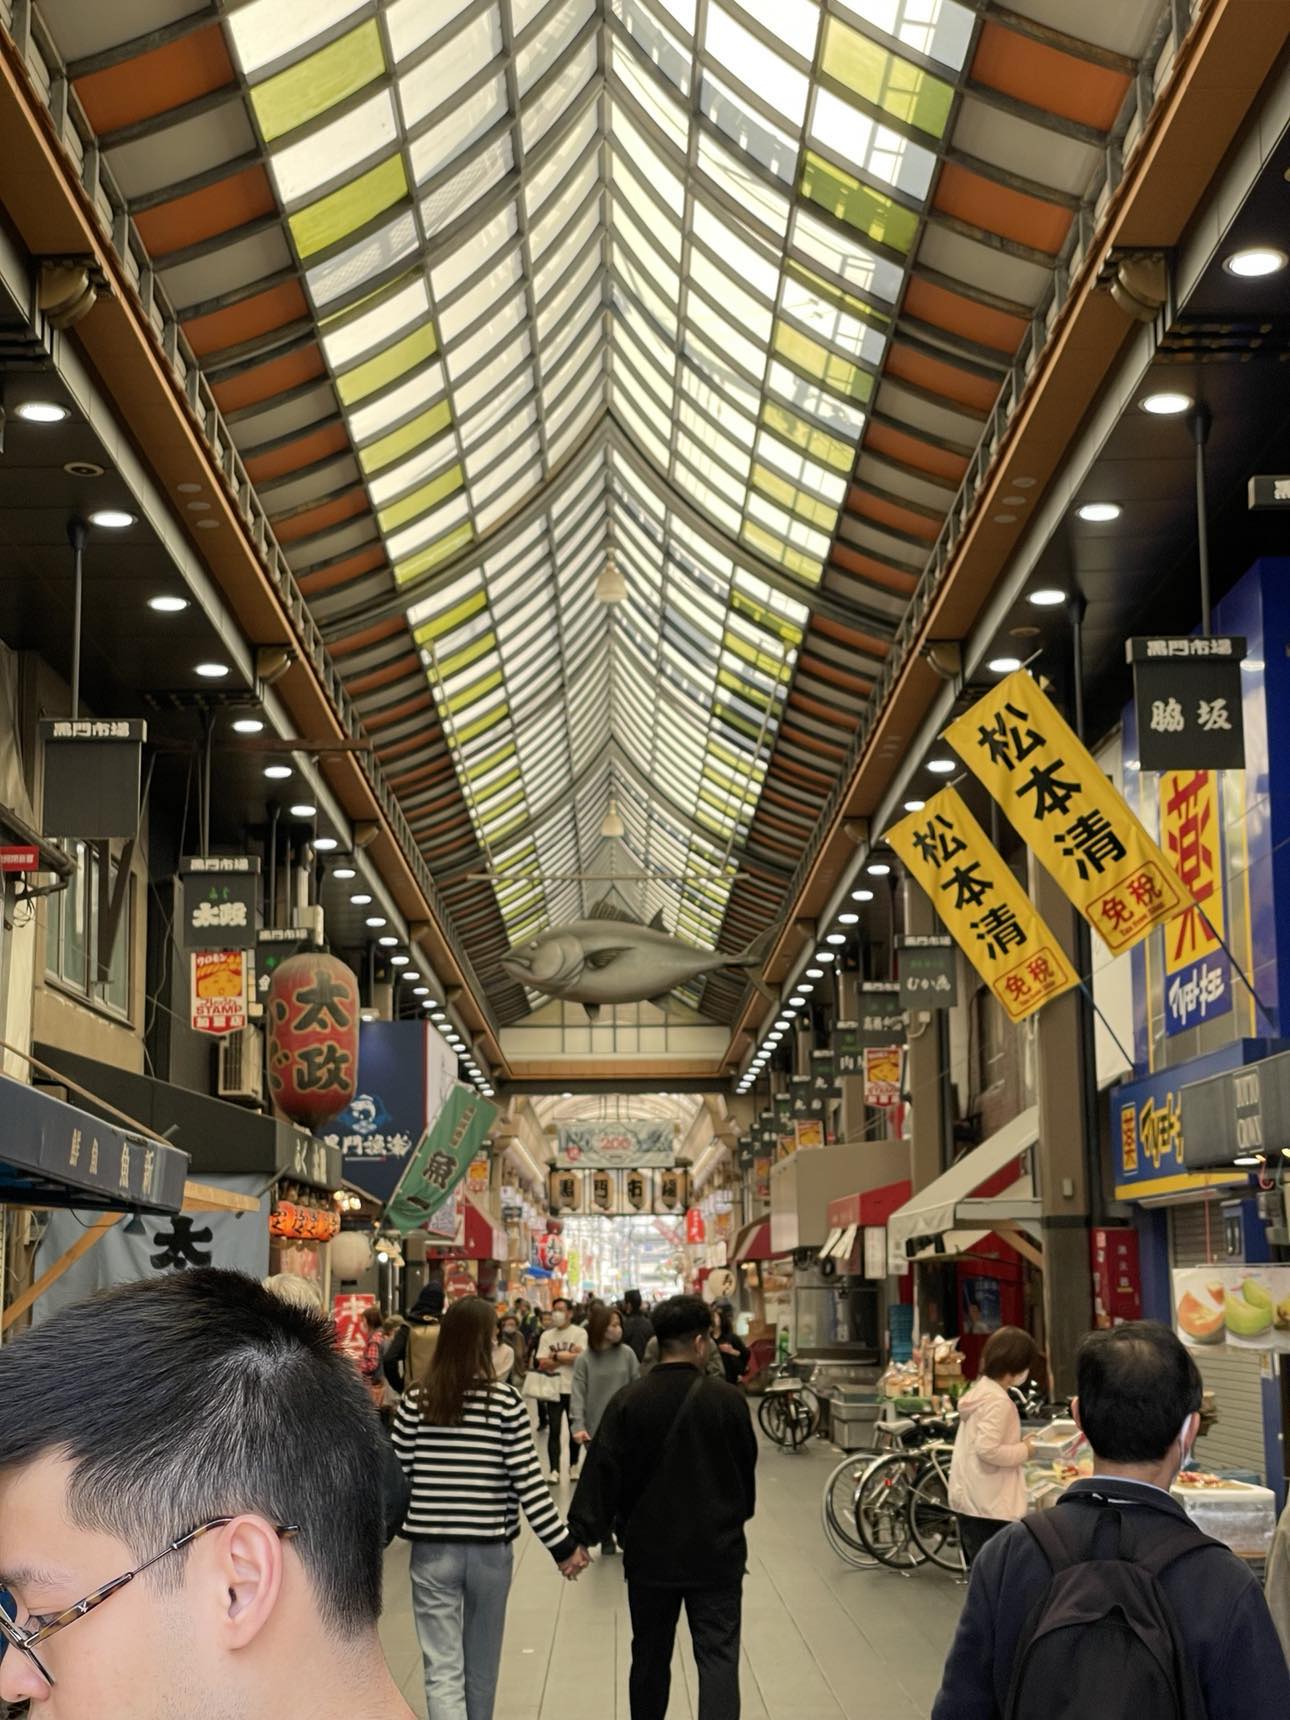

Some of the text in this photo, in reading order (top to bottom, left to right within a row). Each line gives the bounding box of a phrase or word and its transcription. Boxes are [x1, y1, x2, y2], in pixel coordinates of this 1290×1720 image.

[1147, 639, 1232, 655] 黒門市場
[54, 721, 130, 738] 黒門市場
[1151, 699, 1232, 732] 脇坂
[978, 702, 1127, 882] 松本清
[912, 814, 1028, 961] 松本清
[1101, 873, 1163, 931] 免税
[196, 1004, 242, 1015] STAMP
[293, 970, 352, 1091] 太政
